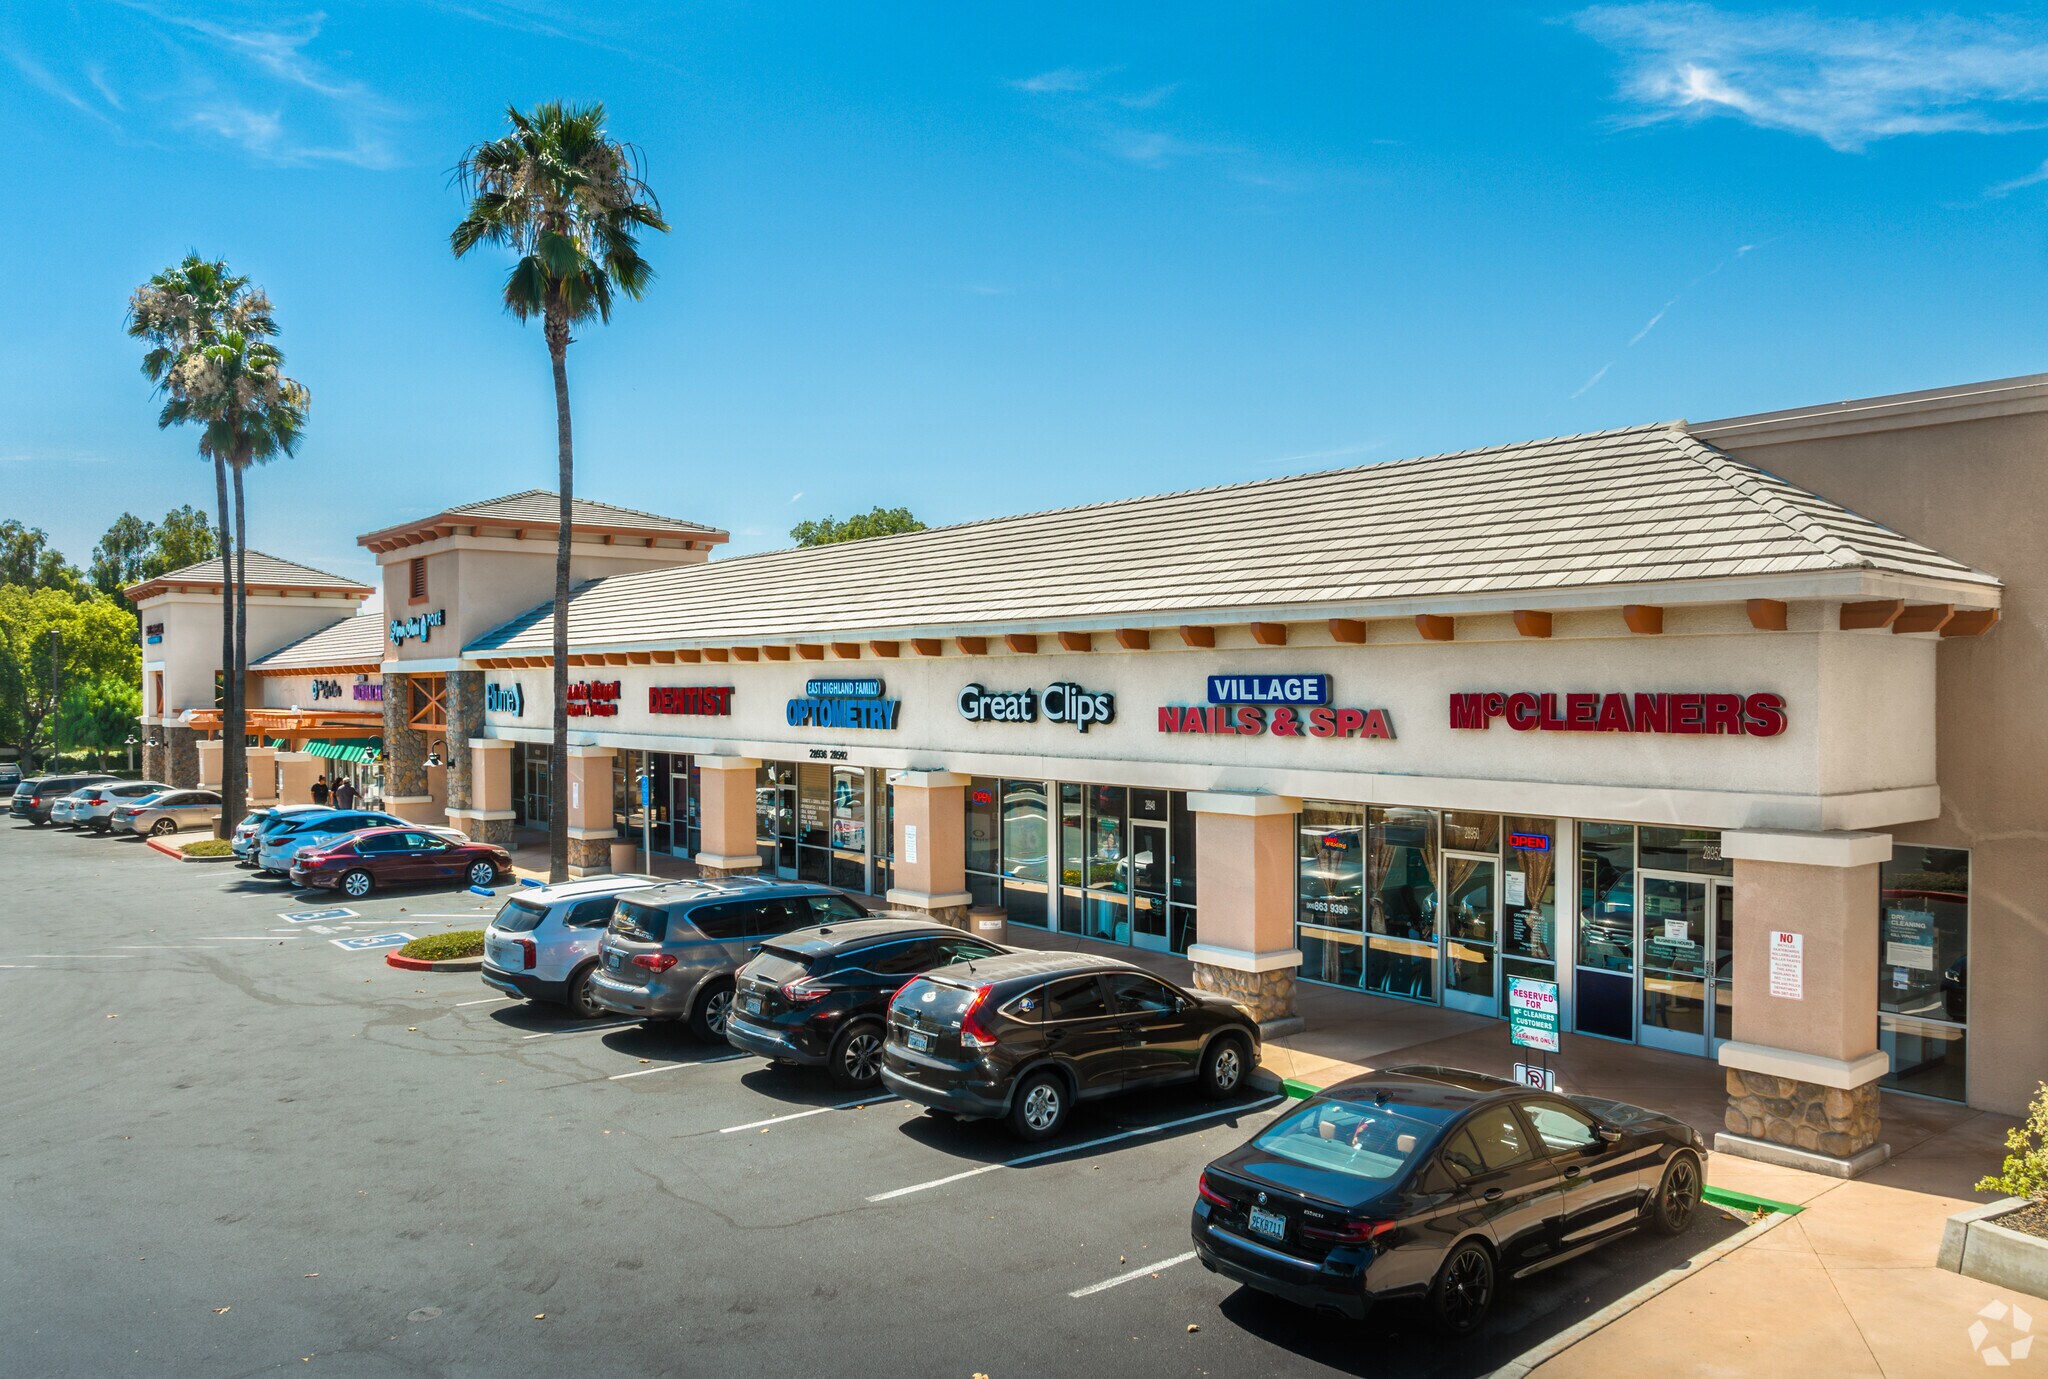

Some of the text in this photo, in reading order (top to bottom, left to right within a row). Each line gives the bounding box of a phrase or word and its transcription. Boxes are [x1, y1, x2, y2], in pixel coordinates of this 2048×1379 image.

[808, 682, 878, 695] EAST HIGHLAND FAMILY
[1214, 679, 1319, 701] VILLAGE
[649, 687, 732, 715] DENTIST
[786, 699, 897, 730] OPTOMETRY
[957, 684, 1111, 732] Great Clips
[1158, 706, 1394, 739] NAILS & SPA
[972, 791, 991, 803] OPEN
[1509, 835, 1546, 848] OPEN
[1330, 903, 1348, 914] 9396
[1891, 920, 1926, 929] CLEANING
[1780, 933, 1793, 943] NO
[1513, 989, 1554, 1003] RESERVED
[1526, 1000, 1541, 1009] FOR
[1523, 1010, 1555, 1021] CLEANERS
[1516, 1017, 1552, 1029] CUSTOMERS
[1515, 1032, 1555, 1045] PARKING ONLY
